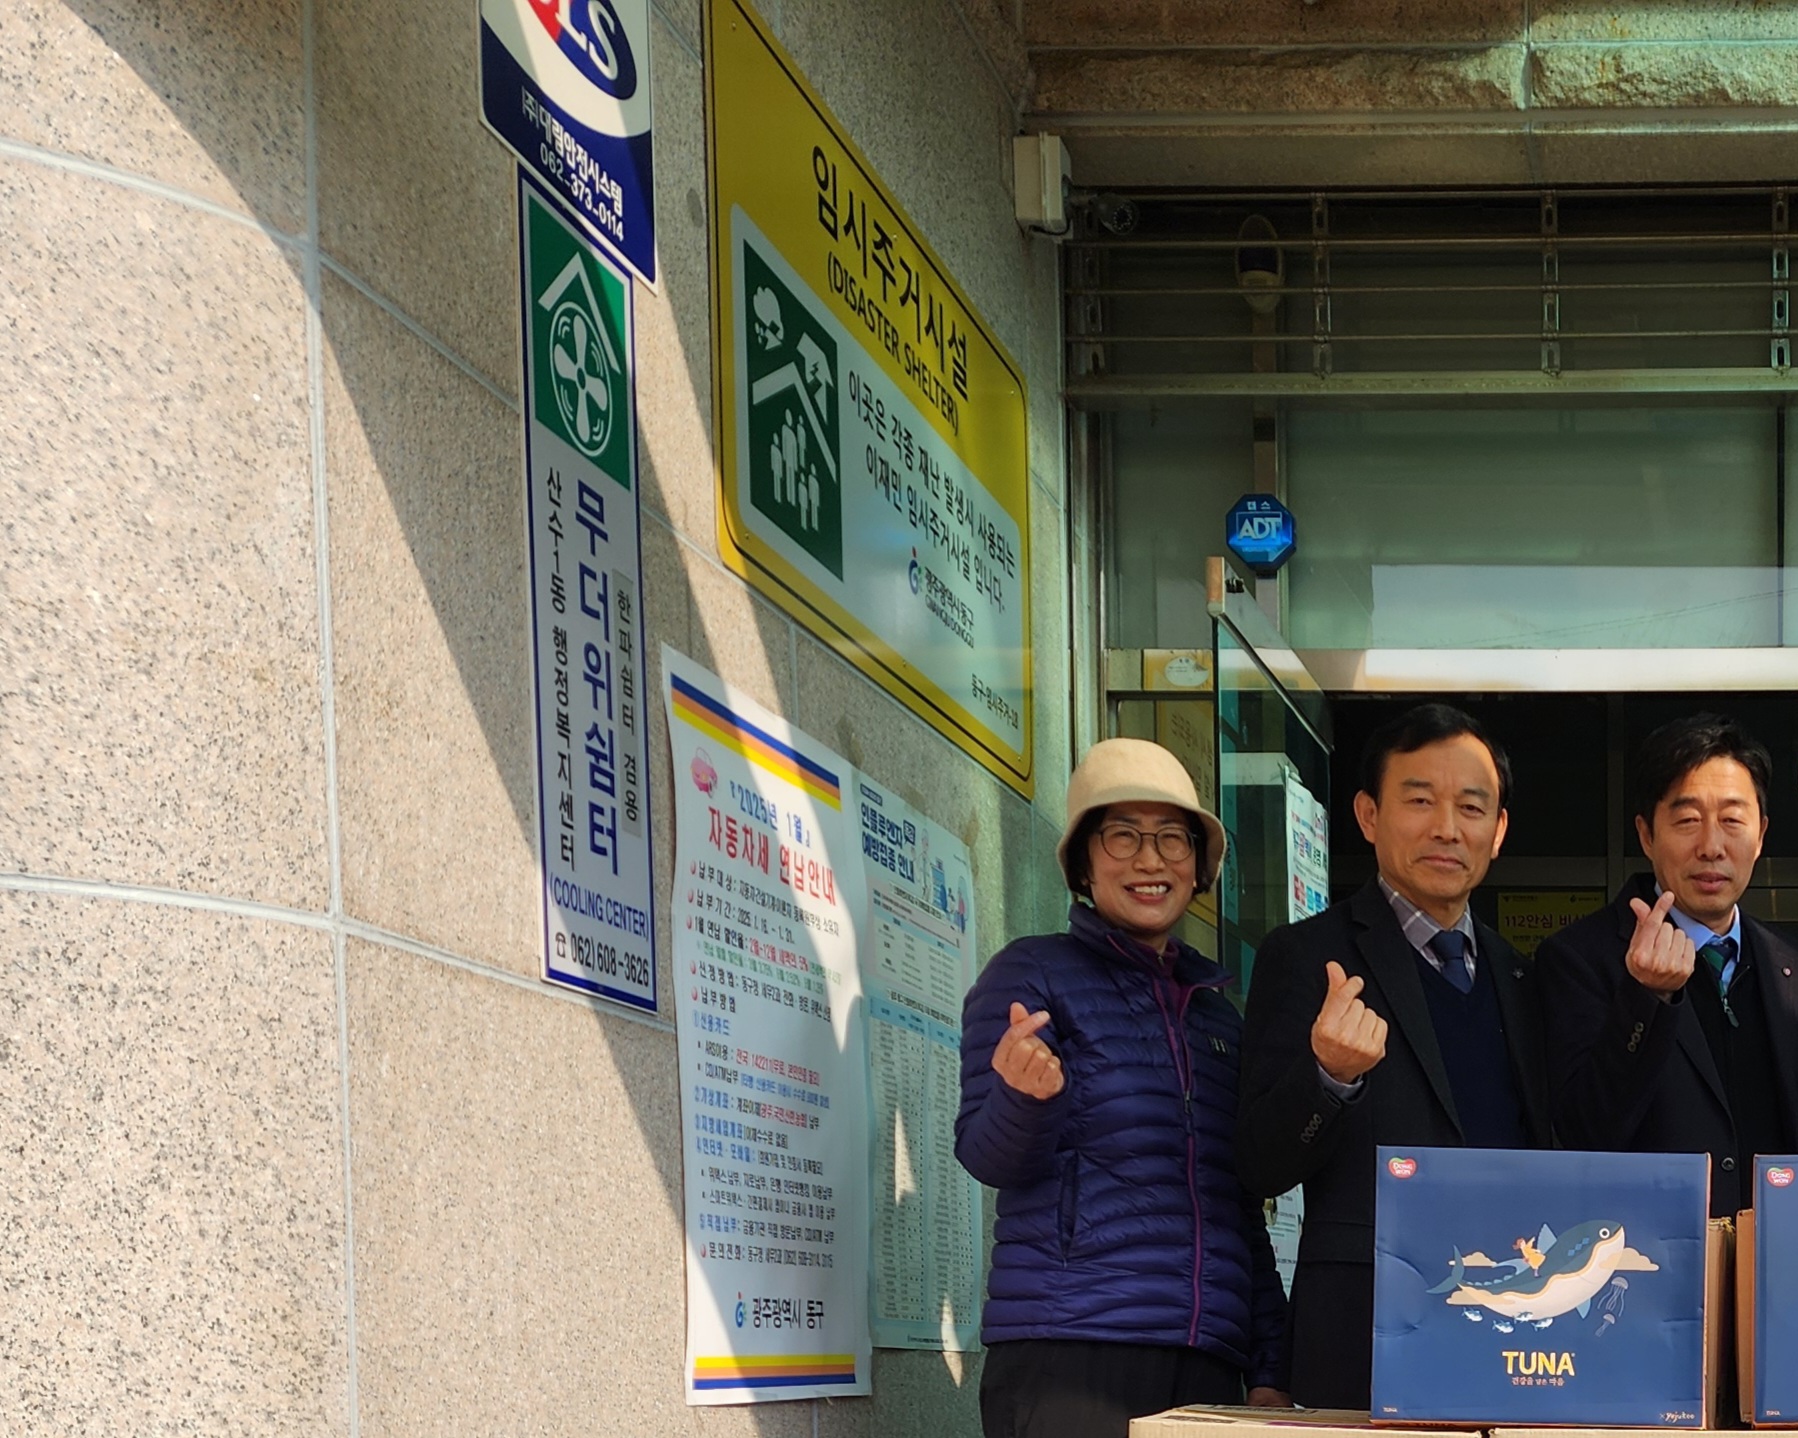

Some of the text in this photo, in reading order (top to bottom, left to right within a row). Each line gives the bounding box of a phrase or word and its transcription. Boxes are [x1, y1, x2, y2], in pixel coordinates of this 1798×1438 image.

[540, 142, 624, 242] 062-373-0114
[812, 145, 969, 402] 임시주거시설
[827, 251, 958, 436] (DISASTER SHELTER)
[849, 369, 887, 442] 이곳은
[891, 414, 914, 471] 각종
[918, 446, 940, 500] 재난
[943, 473, 974, 538] 발생시
[866, 443, 903, 513] 이재민
[906, 484, 971, 583] 임시주거시설
[1239, 517, 1281, 540] ADT
[547, 467, 576, 872] 산수1동 행정복지센터
[575, 478, 619, 877] 무더위쉼터
[708, 804, 770, 875] 자동차세
[779, 843, 836, 906] 연납안내
[860, 802, 904, 851] 인플루엔자
[861, 832, 915, 884] 예방접종 안내
[549, 872, 649, 942] (COOLING CENTER)
[1504, 914, 1553, 929] 112안심
[752, 1297, 825, 1330] 광주광역시 동구
[1502, 1350, 1576, 1377] TUNA
